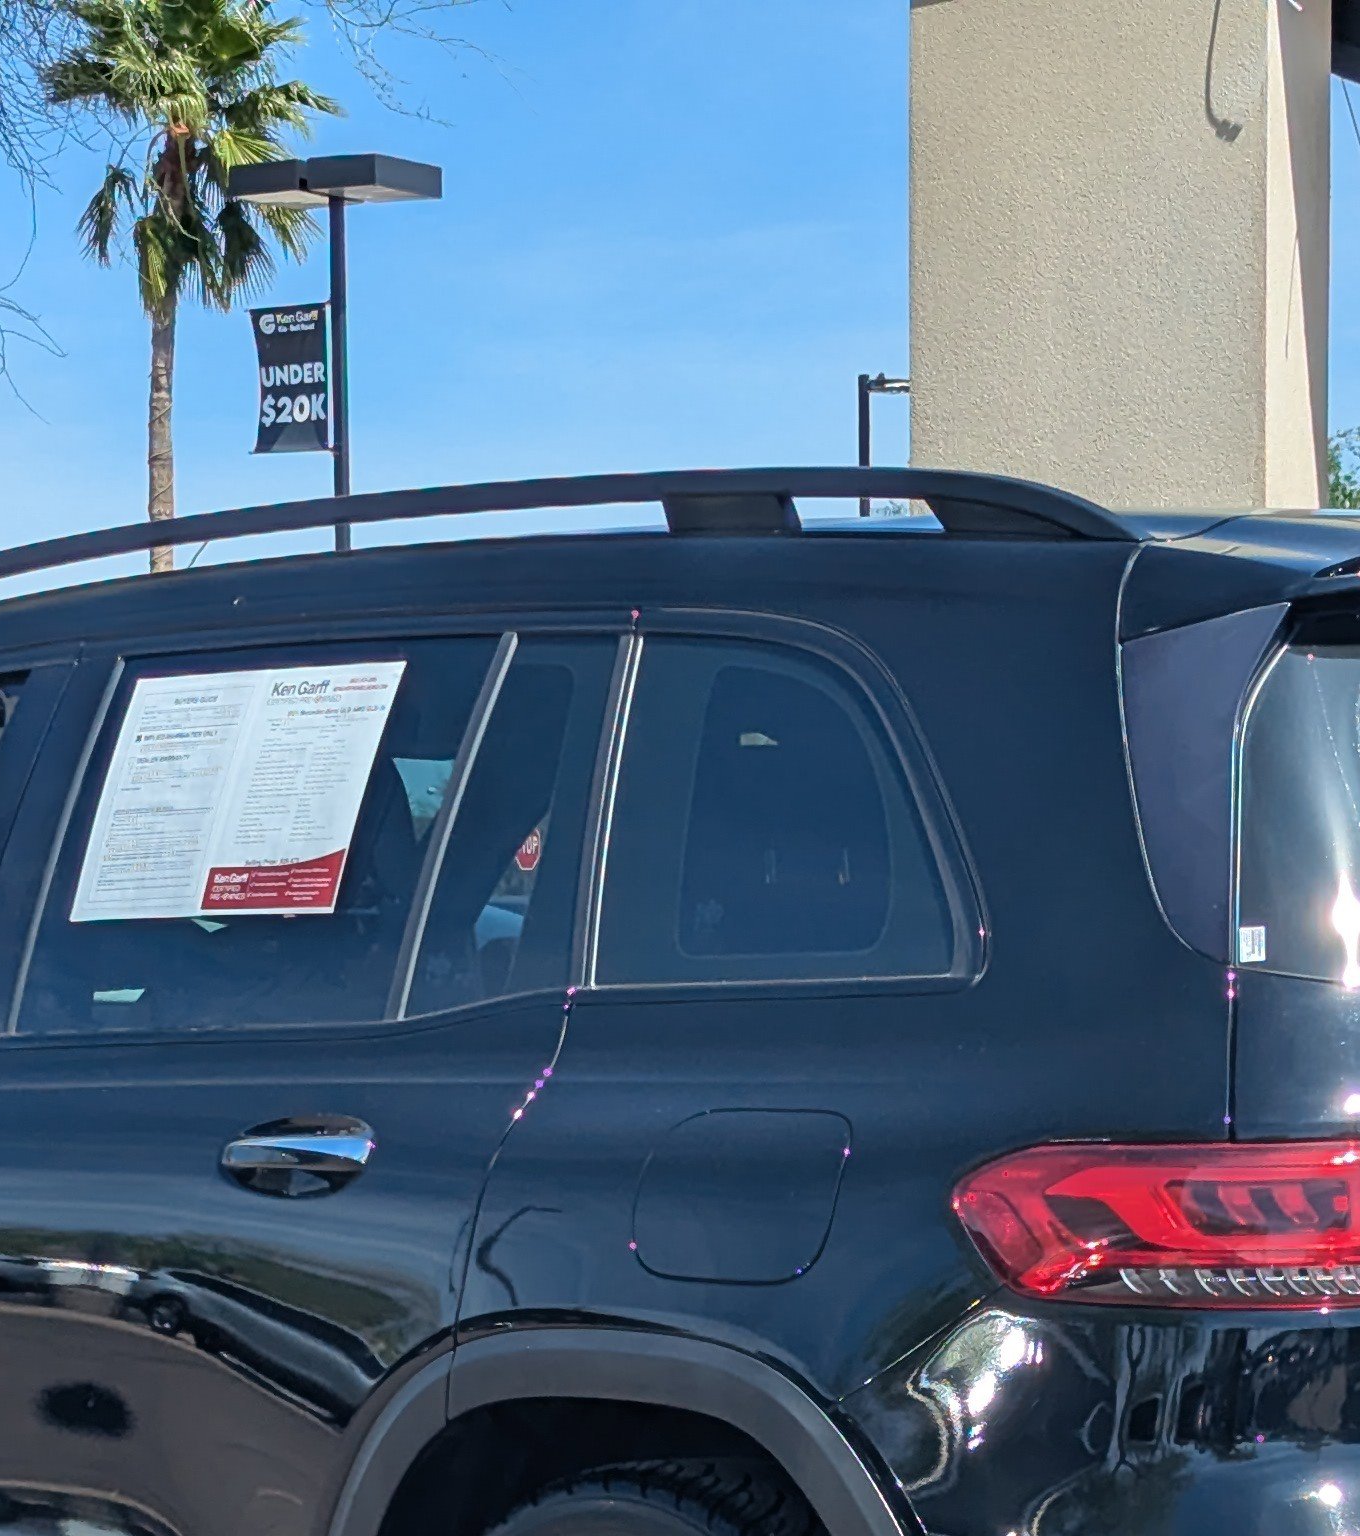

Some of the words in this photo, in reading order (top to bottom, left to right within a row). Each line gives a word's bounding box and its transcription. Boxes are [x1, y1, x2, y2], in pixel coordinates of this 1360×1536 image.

[261, 361, 326, 388] UNDER
[261, 393, 327, 428] $20K
[271, 682, 296, 696] Ken
[298, 679, 330, 695] Garff
